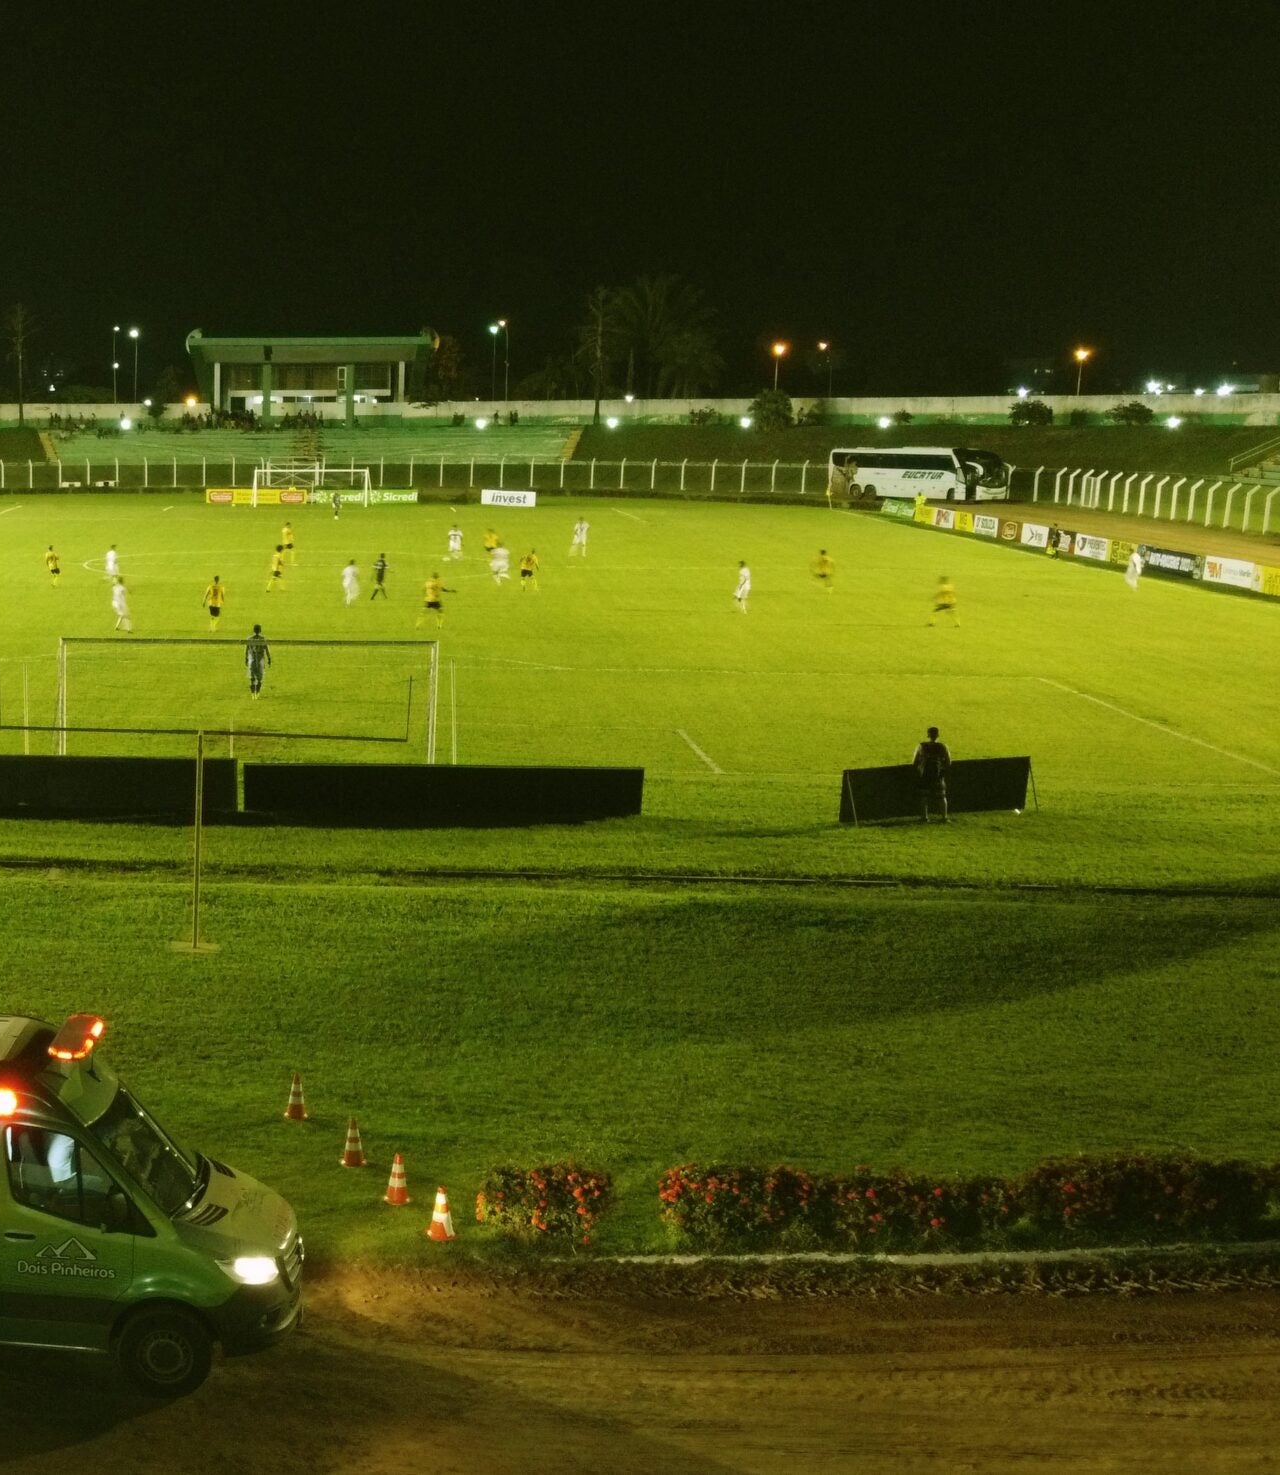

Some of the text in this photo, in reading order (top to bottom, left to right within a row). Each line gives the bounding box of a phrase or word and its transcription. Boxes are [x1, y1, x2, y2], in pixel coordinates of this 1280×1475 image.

[901, 470, 945, 480] EUCATUR
[330, 491, 364, 501] Scredi
[383, 491, 418, 501] Sicredi
[491, 492, 527, 504] invest
[17, 1260, 116, 1279] Dois Pinheiros
